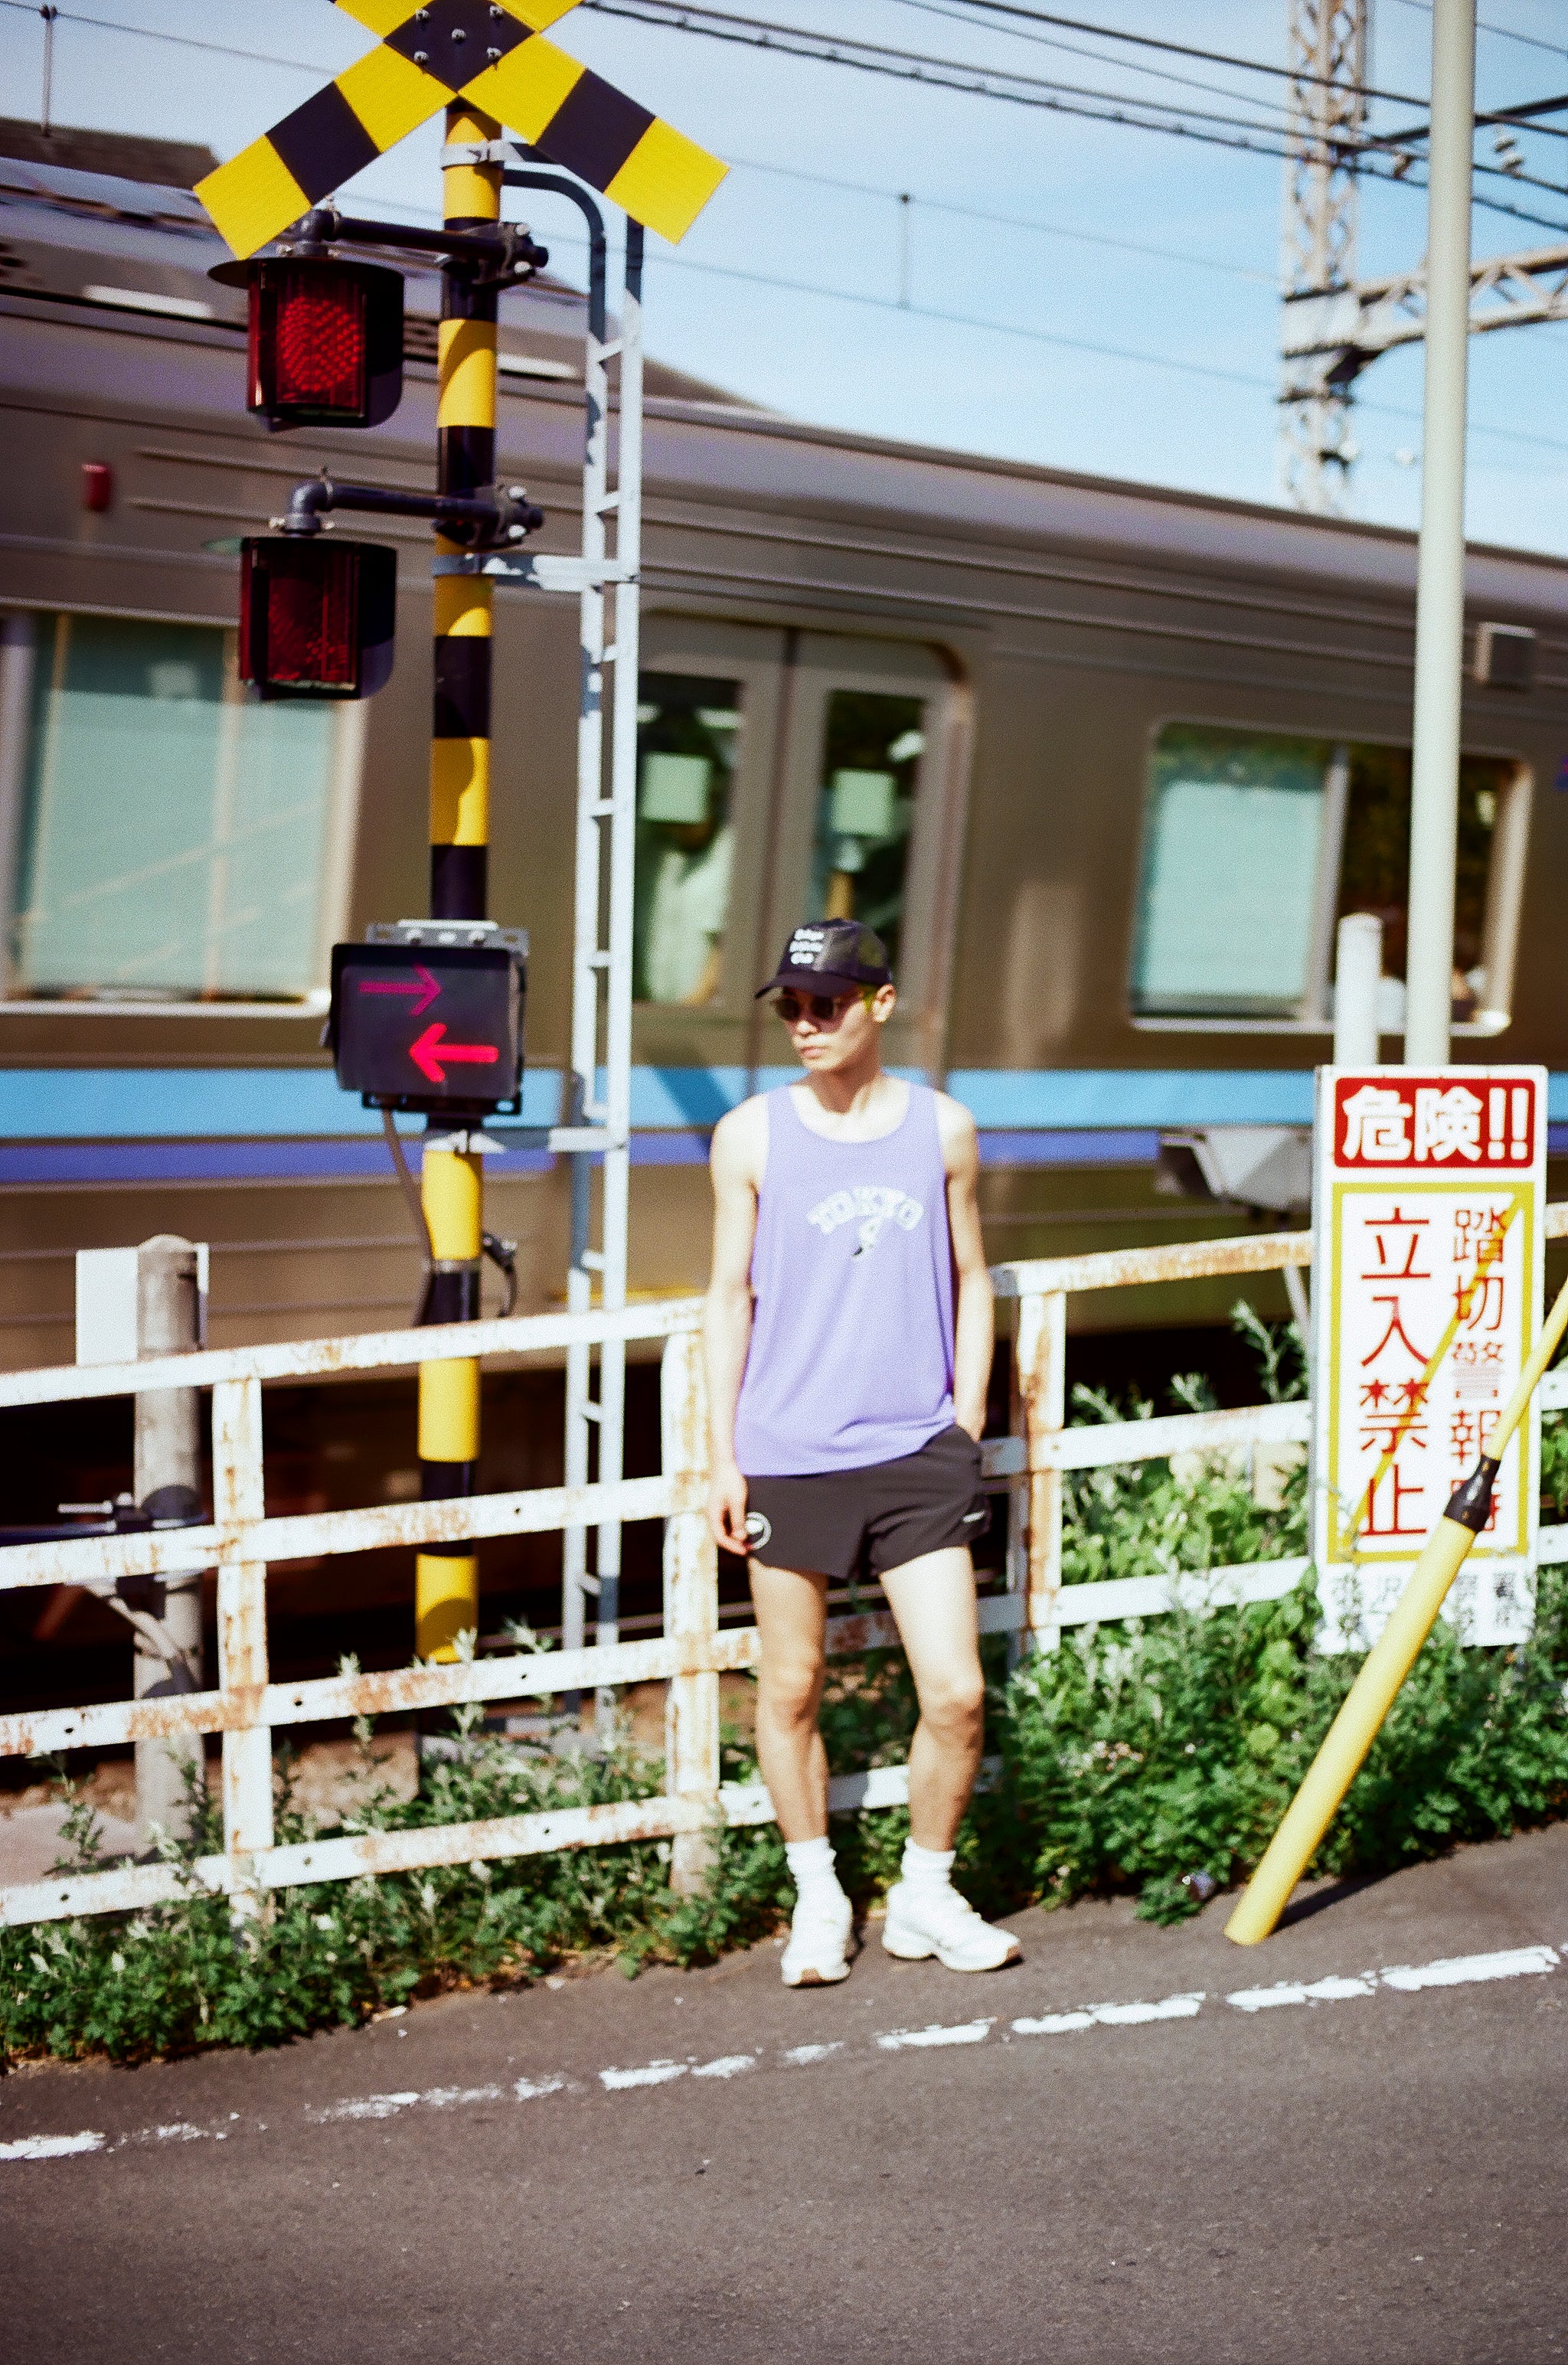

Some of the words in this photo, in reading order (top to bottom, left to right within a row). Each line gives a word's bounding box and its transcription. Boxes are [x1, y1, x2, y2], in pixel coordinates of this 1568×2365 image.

[1342, 1084, 1530, 1162] 危険!!
[805, 1186, 925, 1235] TOKYO
[1361, 1207, 1431, 1537] 立入禁止
